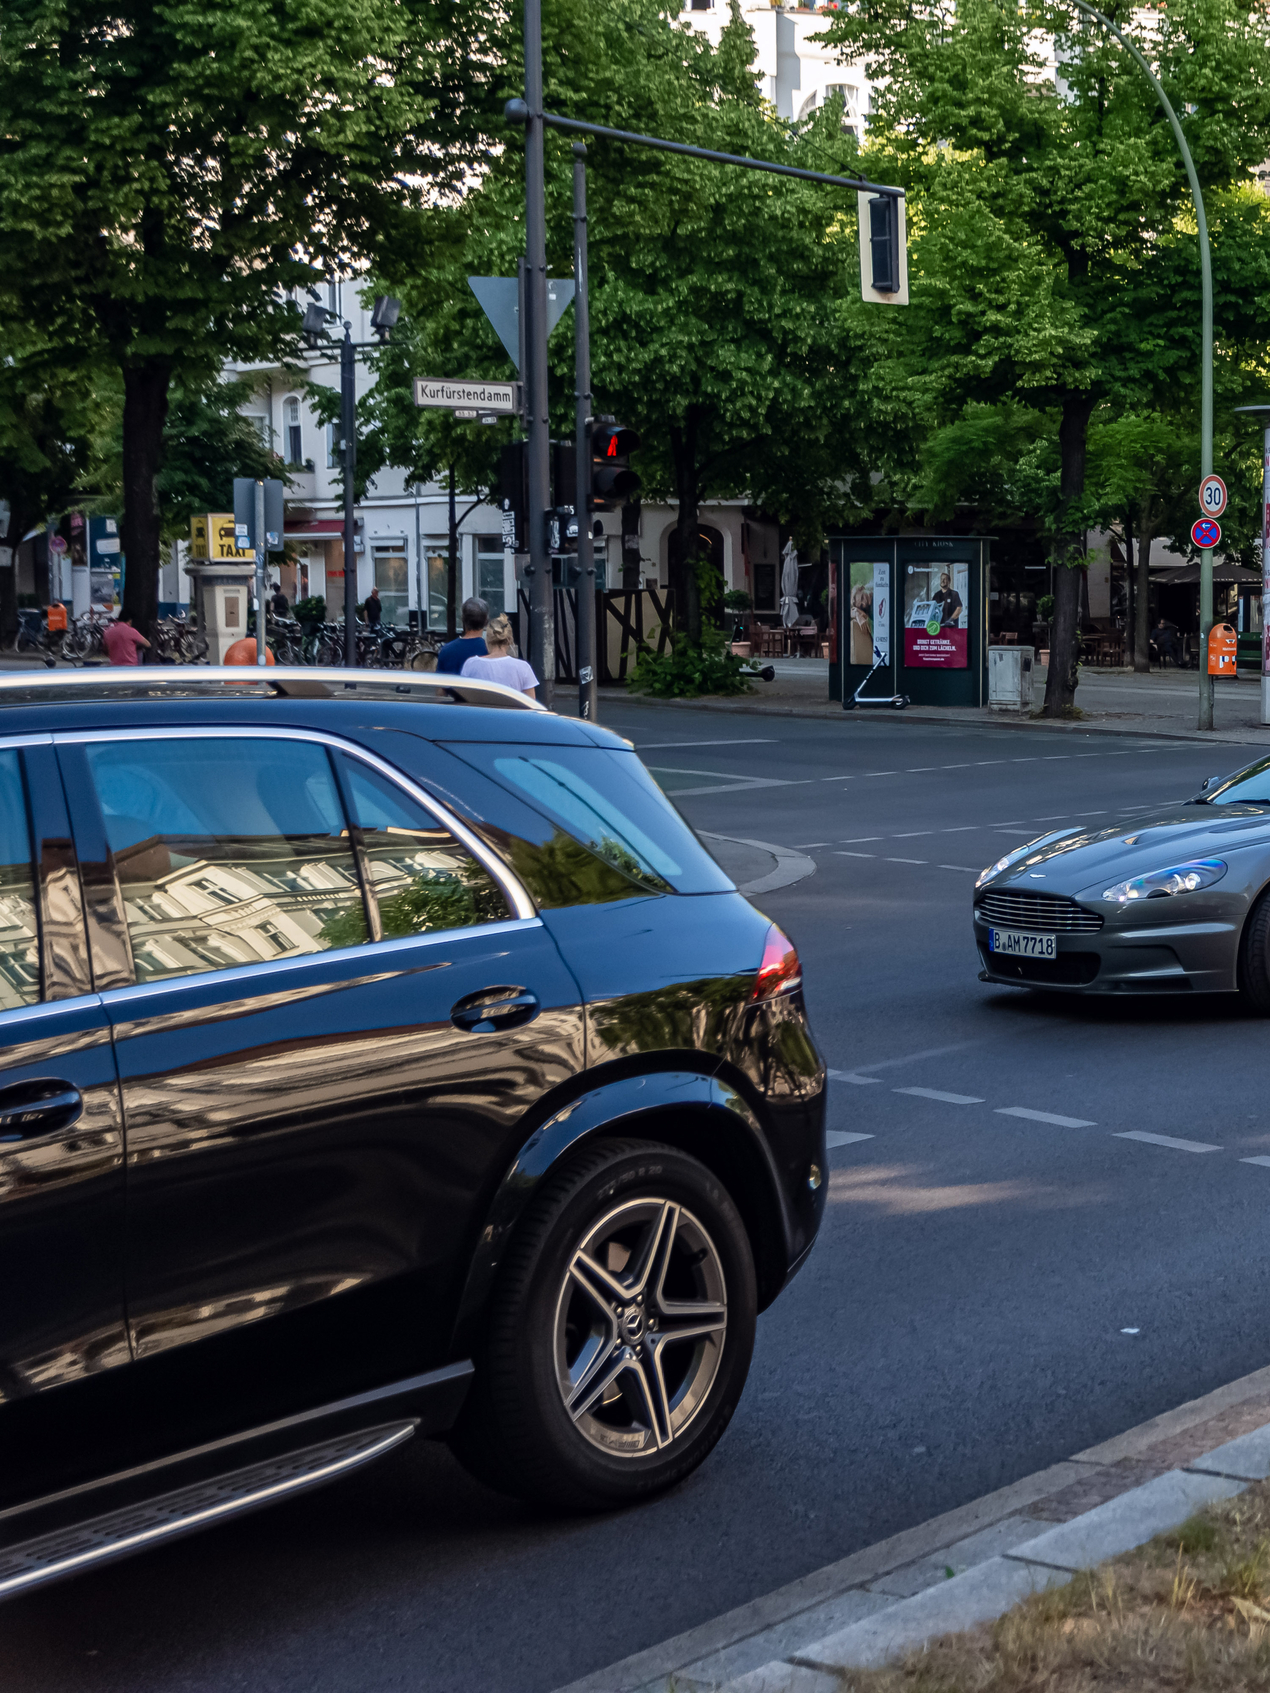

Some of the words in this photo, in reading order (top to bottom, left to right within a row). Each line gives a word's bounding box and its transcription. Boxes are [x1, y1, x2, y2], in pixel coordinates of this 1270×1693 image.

[421, 384, 511, 402] Kurfürstendamm
[1205, 486, 1221, 506] 30
[219, 543, 246, 557] TAXI
[994, 932, 1001, 949] B
[1007, 934, 1020, 953] AM
[1022, 936, 1054, 956] 7718
